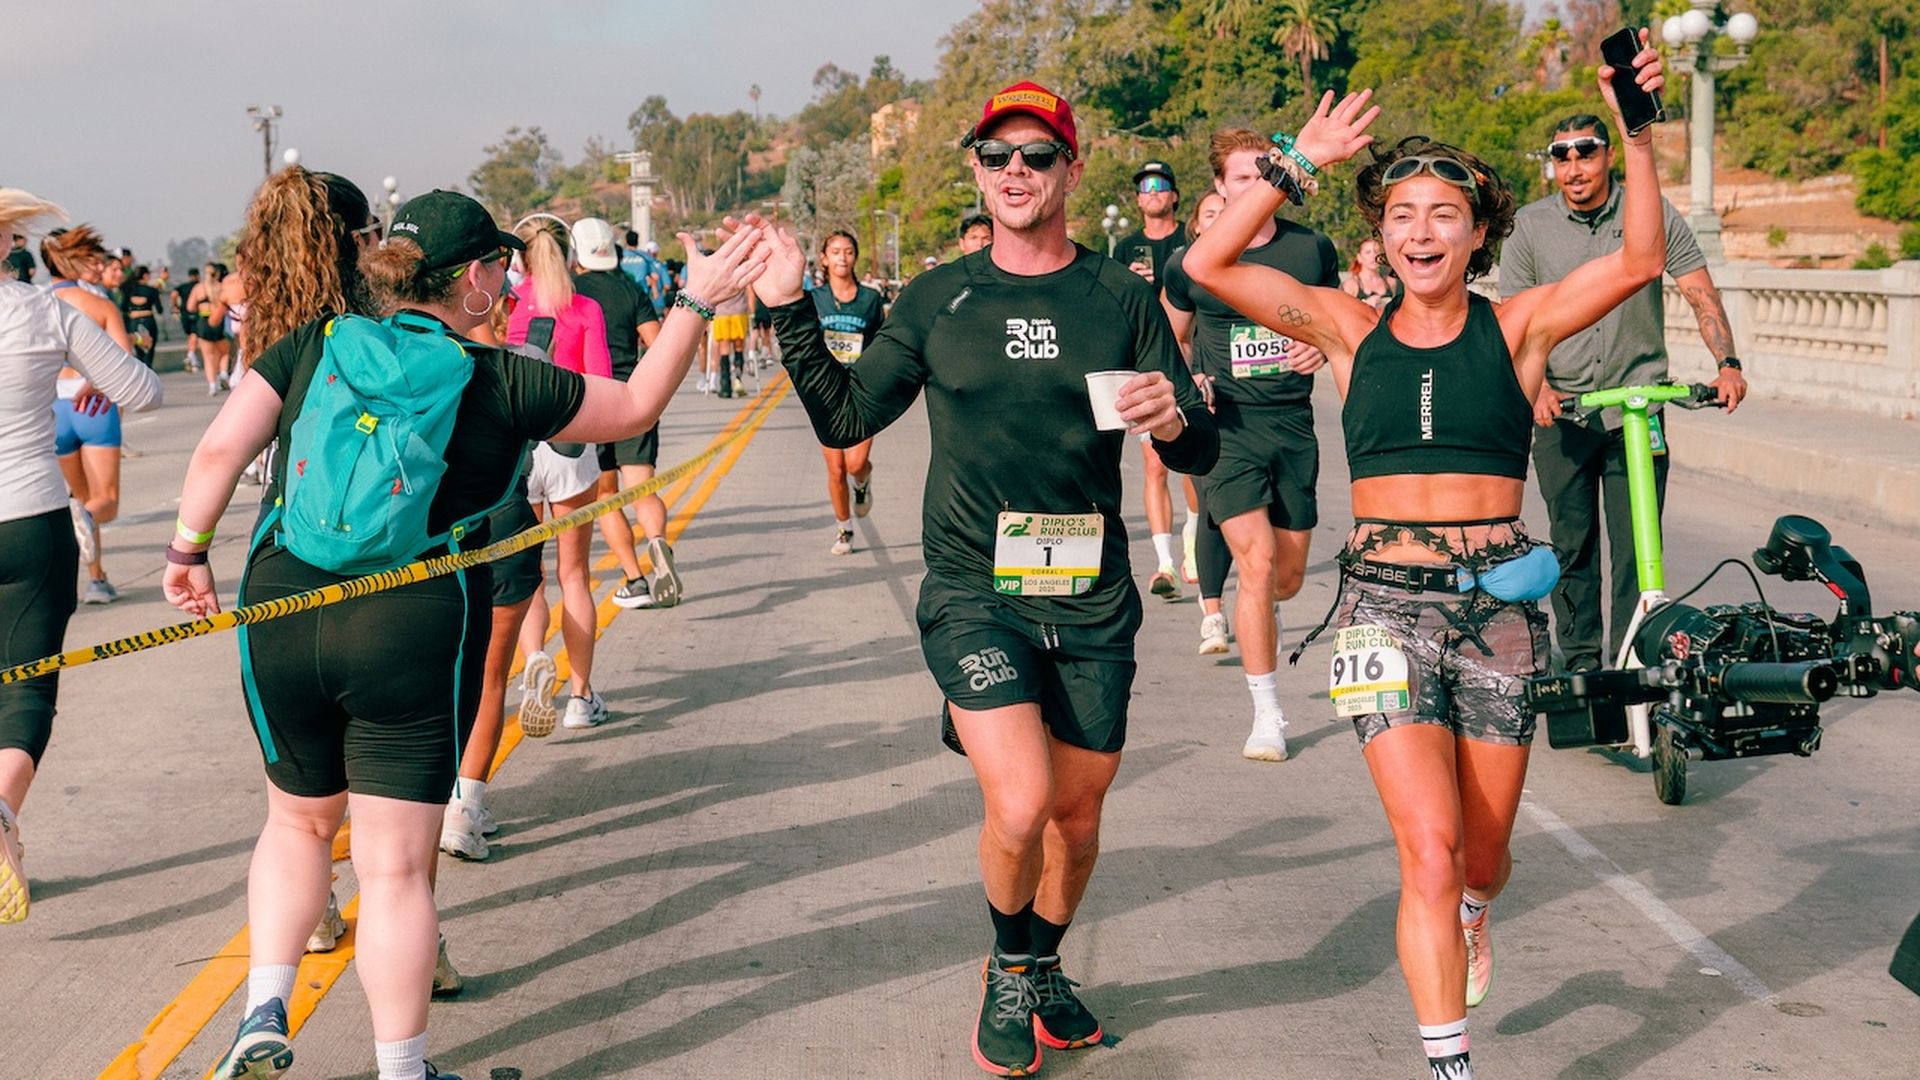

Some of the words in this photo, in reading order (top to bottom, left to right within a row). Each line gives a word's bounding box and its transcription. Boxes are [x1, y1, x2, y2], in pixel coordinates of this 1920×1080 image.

[1005, 318, 1057, 341] Run
[1004, 339, 1060, 360] Club
[1421, 369, 1433, 440] MERRELL
[1041, 517, 1086, 526] DIPLO'S
[1040, 527, 1065, 536] RUN
[1067, 527, 1098, 536] CLUB
[1043, 547, 1052, 566] 1
[1001, 580, 1020, 591] VIP
[1024, 578, 1038, 586] LOS
[1040, 578, 1071, 586] ANGELES
[1345, 627, 1388, 640] DIPLO'S
[1344, 638, 1366, 650] RUN
[958, 651, 1010, 674] Run
[1333, 651, 1384, 686] 916
[970, 664, 1019, 692] Club
